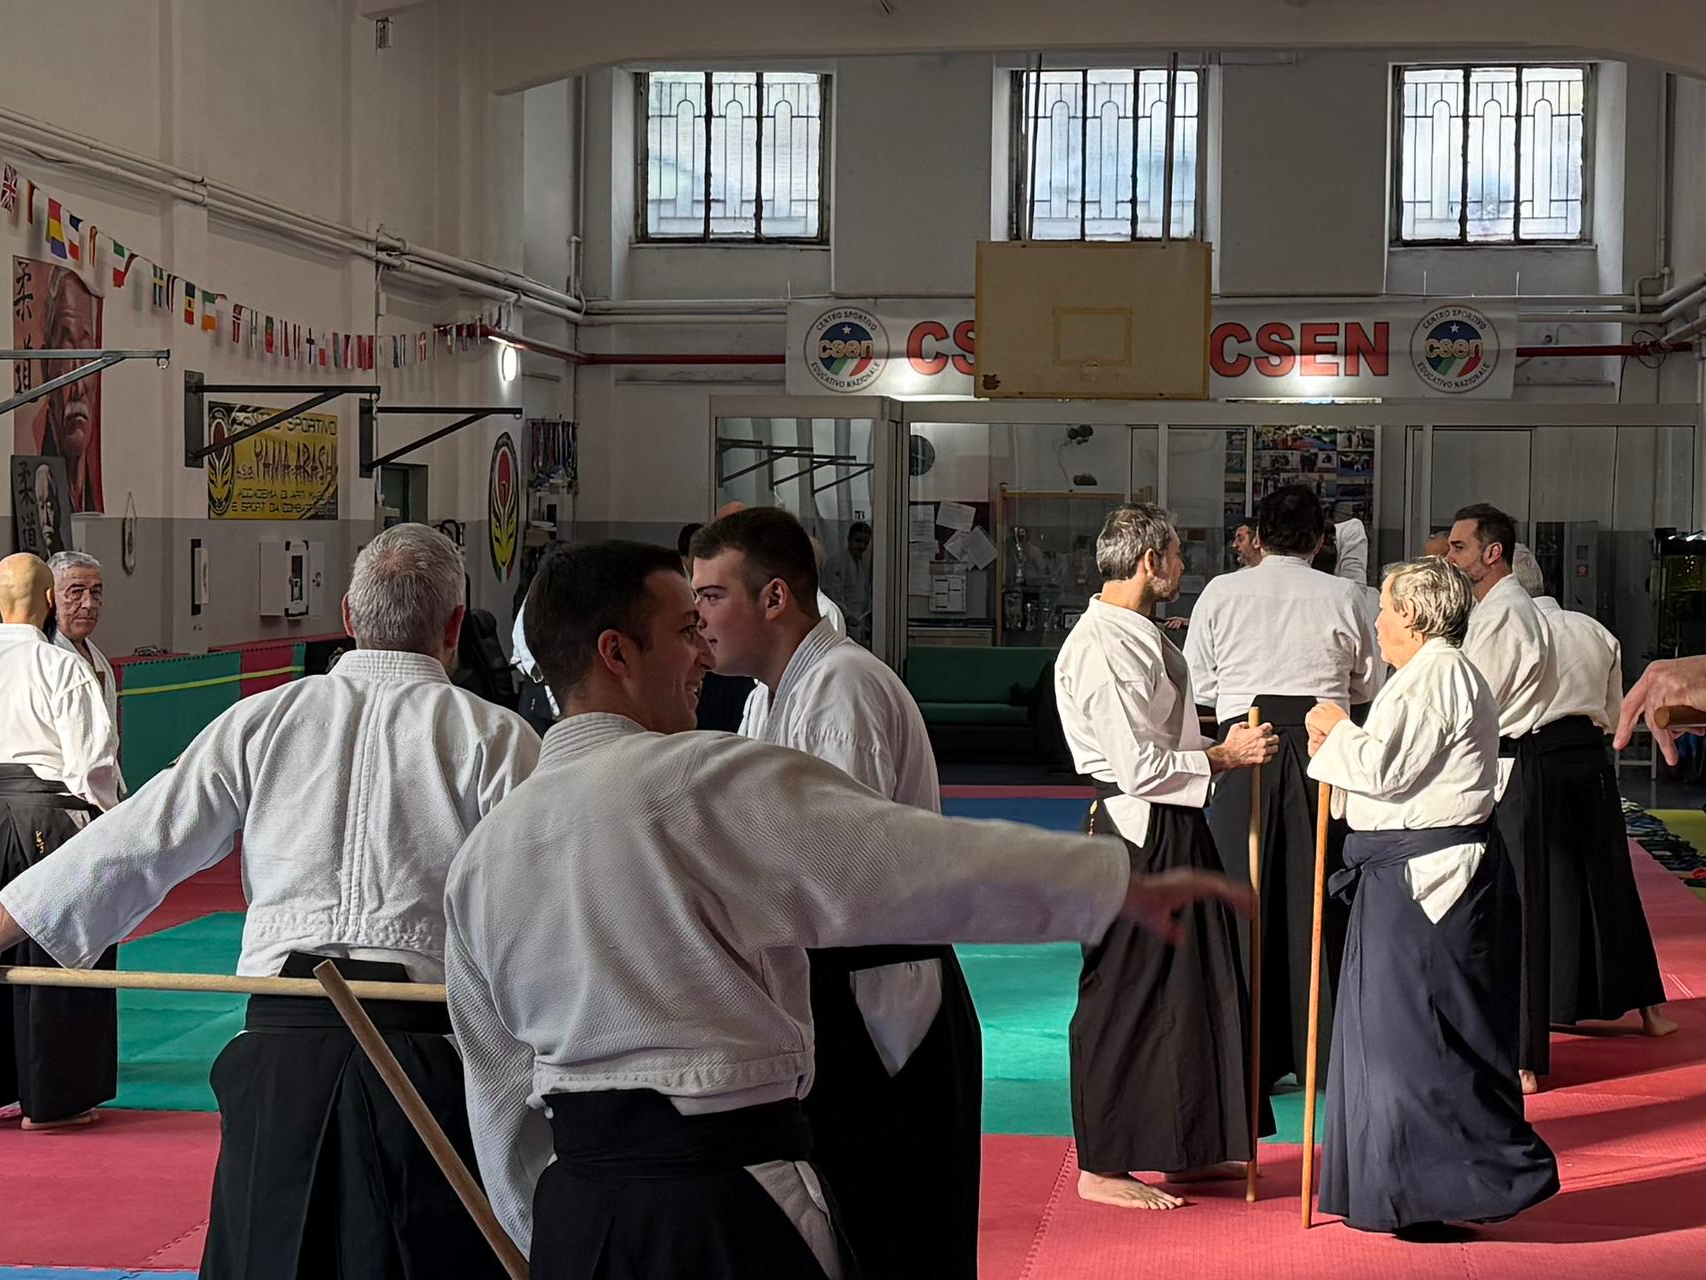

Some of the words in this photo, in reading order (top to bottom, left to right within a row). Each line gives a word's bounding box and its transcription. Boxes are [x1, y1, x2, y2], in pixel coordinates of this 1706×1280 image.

[816, 311, 843, 331] CENTRO
[844, 311, 877, 331] SPORTIVO
[1422, 310, 1451, 330] CENTRO
[1453, 310, 1487, 330] SPORTIVO
[818, 339, 875, 359] csen
[906, 321, 975, 376] CS
[1210, 322, 1389, 377] CSEN
[1425, 338, 1483, 358] csen
[811, 362, 846, 388] EDUCATIVO
[846, 362, 881, 388] NAZIONALE
[287, 417, 337, 436] SPORTIVO
